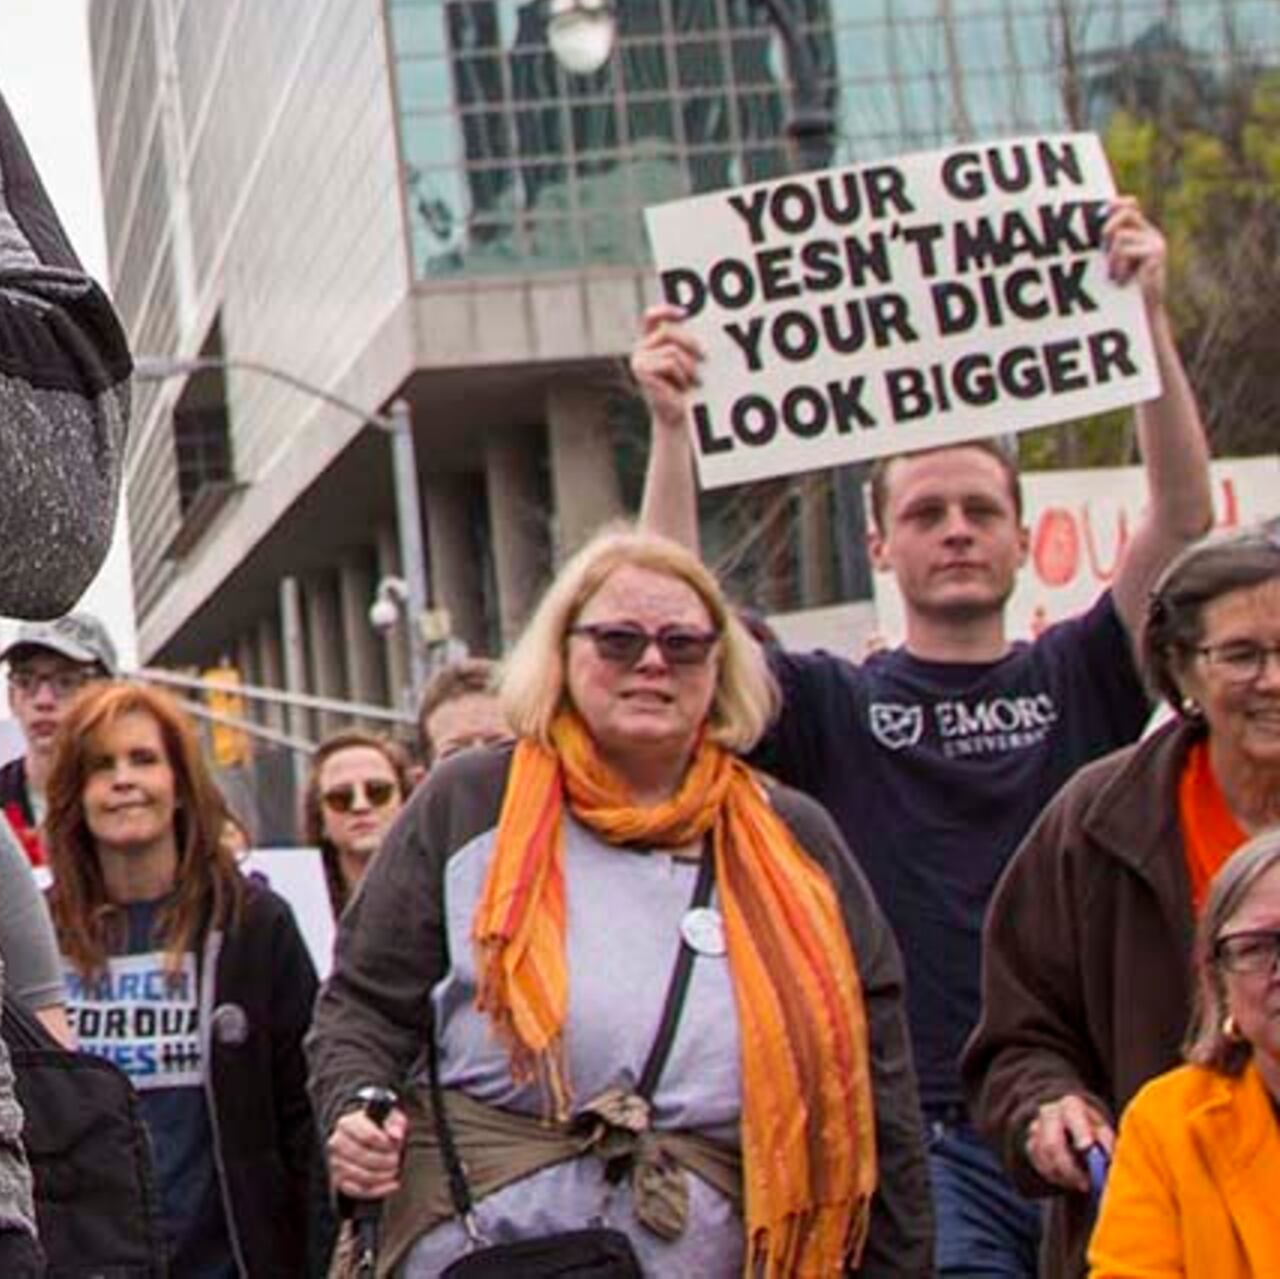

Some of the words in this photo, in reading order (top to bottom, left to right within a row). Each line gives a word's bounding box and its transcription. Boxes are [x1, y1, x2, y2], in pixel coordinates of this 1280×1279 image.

[730, 166, 915, 244] YOUR
[941, 141, 1084, 200] GUN
[661, 220, 945, 318] DOESN'T
[724, 294, 919, 373] YOUR
[931, 260, 1099, 338] DICK
[692, 375, 876, 456] LOOK
[884, 328, 1139, 423] BIGGER
